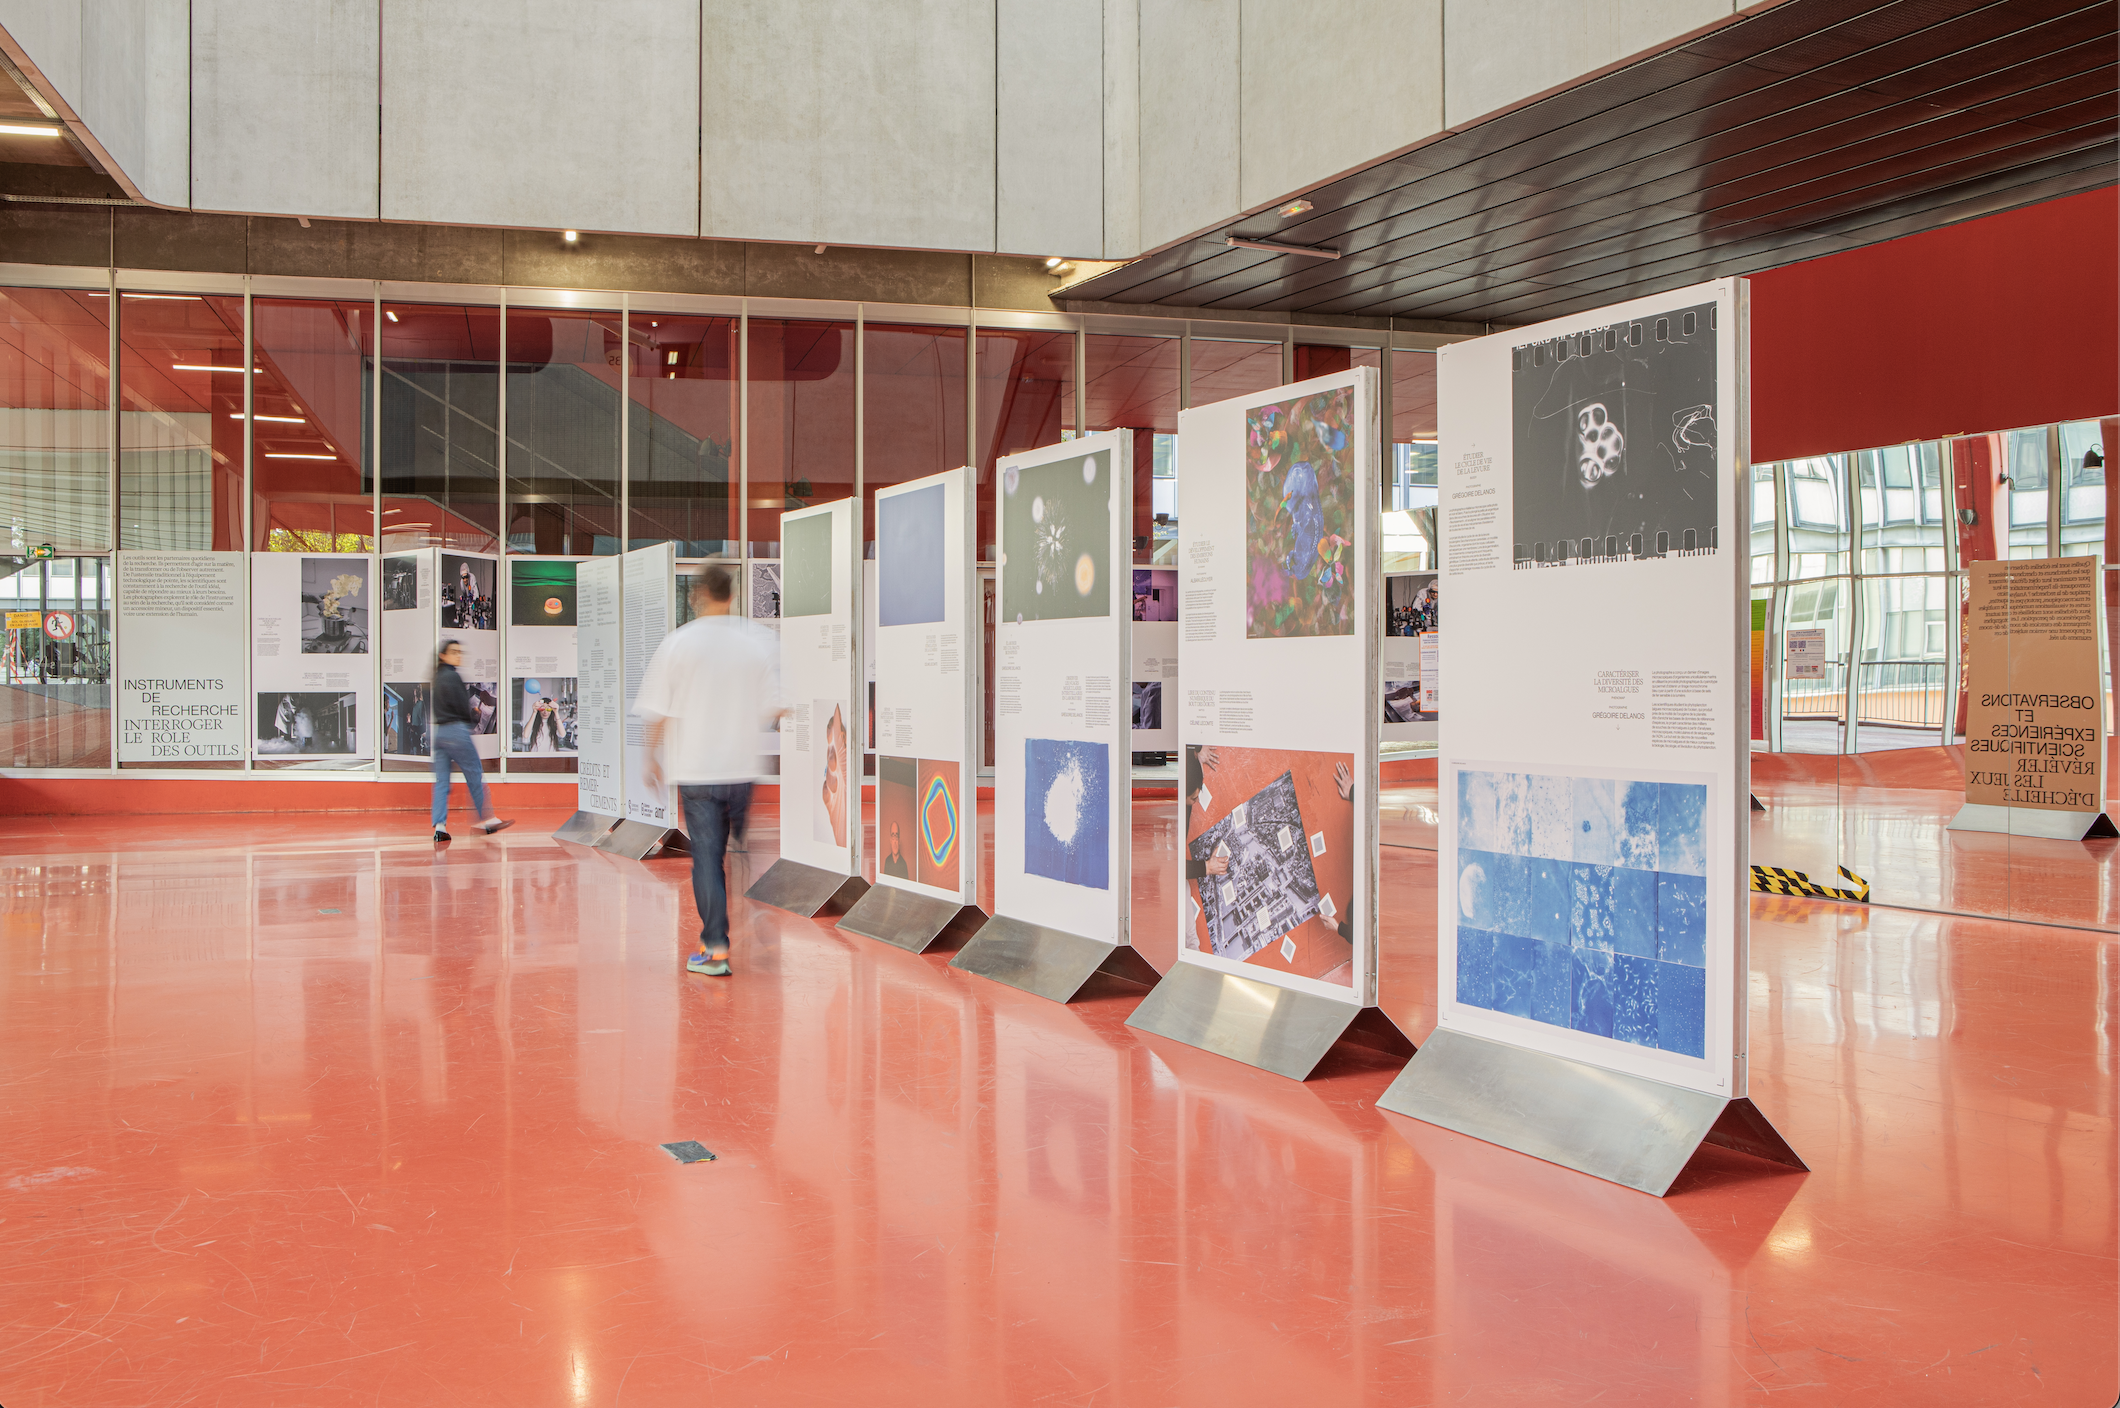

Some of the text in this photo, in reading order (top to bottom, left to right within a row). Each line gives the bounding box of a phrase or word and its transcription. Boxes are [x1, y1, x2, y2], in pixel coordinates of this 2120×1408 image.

[1463, 451, 1483, 460] ÉTUDIER
[1460, 460, 1476, 468] CYCLE
[1484, 457, 1493, 465] VIE
[1470, 465, 1490, 474] LEVURE
[1452, 488, 1496, 499] GRÉGOIRE DELANOS
[1597, 669, 1640, 677] CARACTÉRISER
[124, 679, 224, 690] INSTRUMENTS
[1602, 677, 1631, 685] DIVERSITÉ
[142, 692, 161, 703] DE
[152, 705, 239, 716] RECHERCHE
[1592, 711, 1646, 720] GRÉGOIRE DELANOS
[124, 719, 223, 730] INTERROGER
[124, 729, 190, 743] LE RÔLE
[151, 744, 239, 756] DES OUTILS
[579, 758, 610, 778] CRÉDITS ET
[579, 777, 599, 792] REMER-
[590, 794, 617, 811] CIEMENTS
